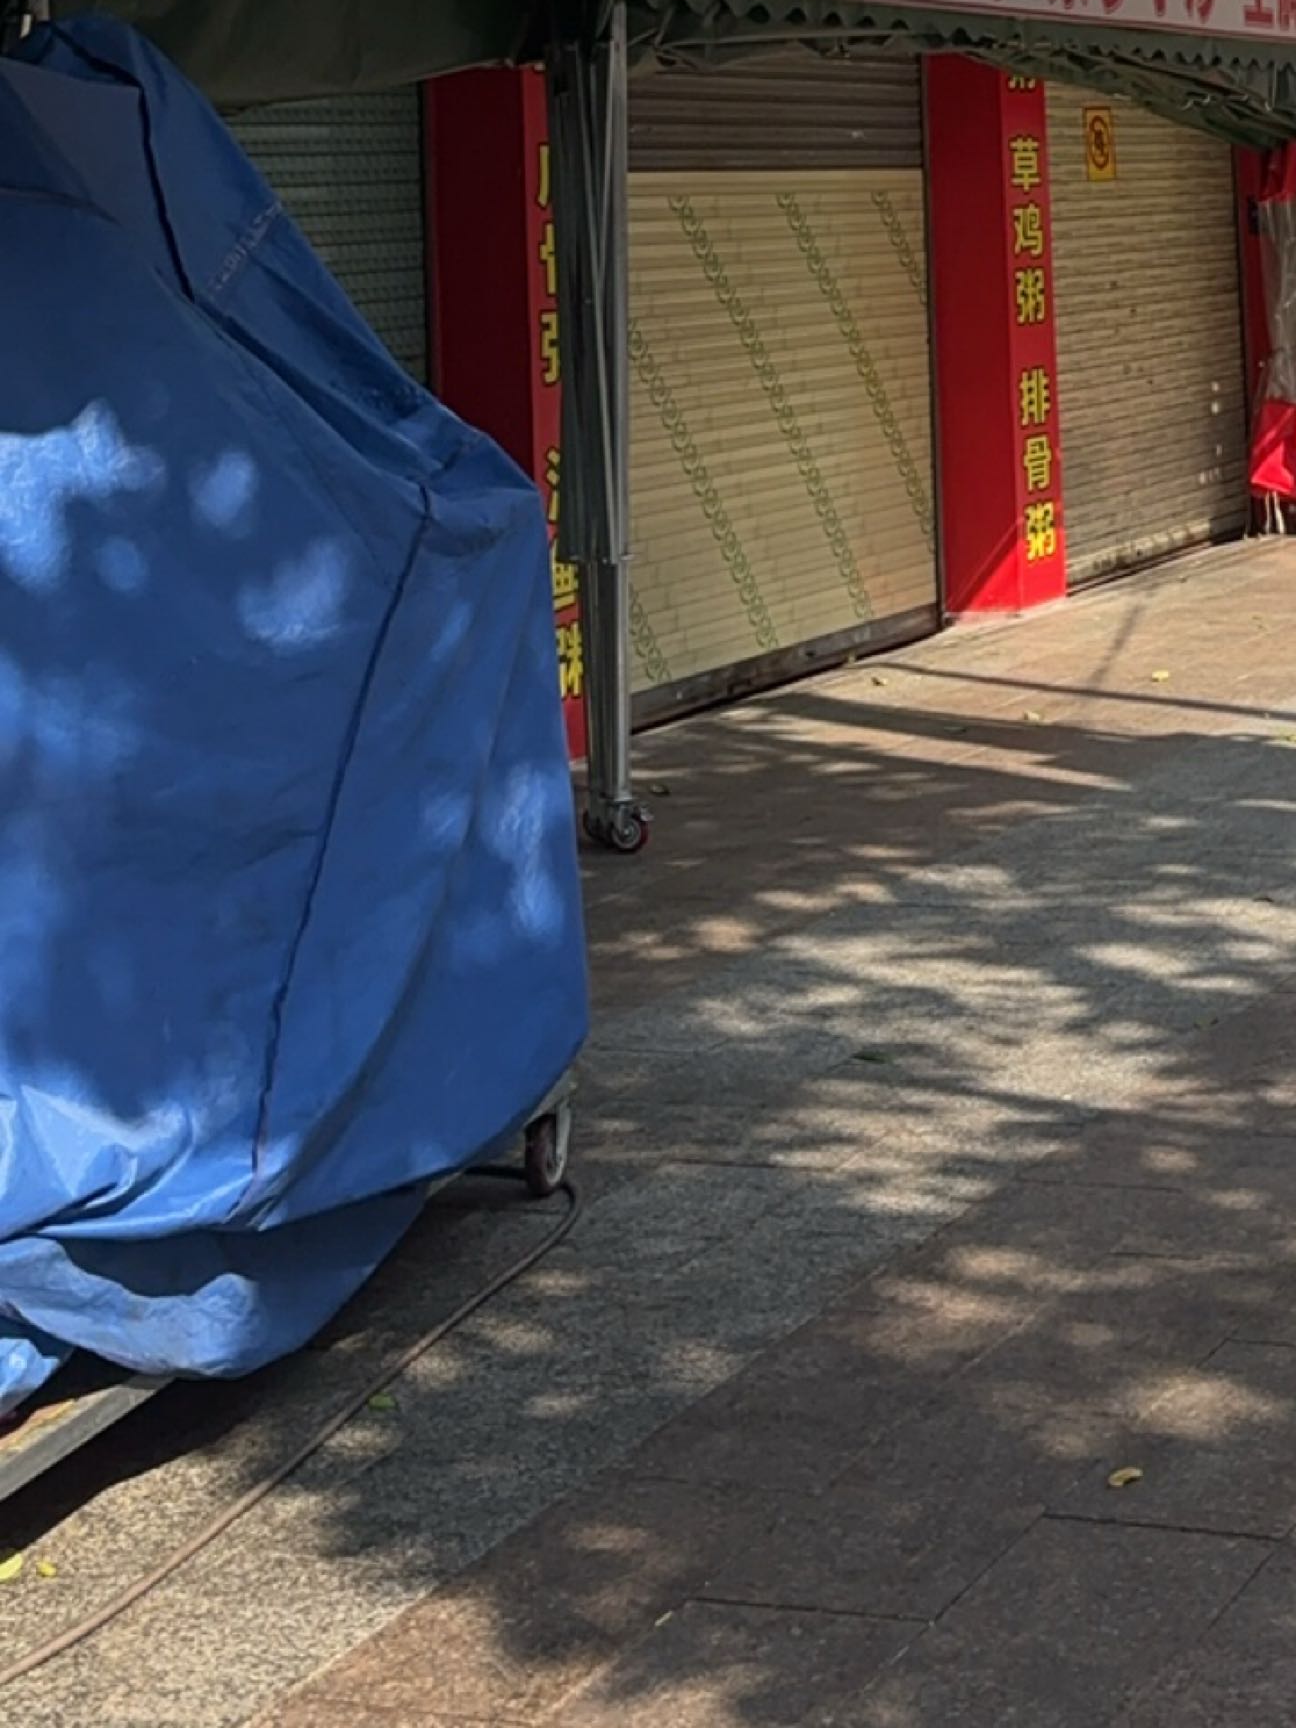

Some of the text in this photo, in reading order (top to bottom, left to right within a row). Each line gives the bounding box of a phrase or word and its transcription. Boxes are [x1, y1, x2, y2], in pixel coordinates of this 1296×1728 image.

[1008, 137, 1056, 564] 草鸡粥 排骨粥
